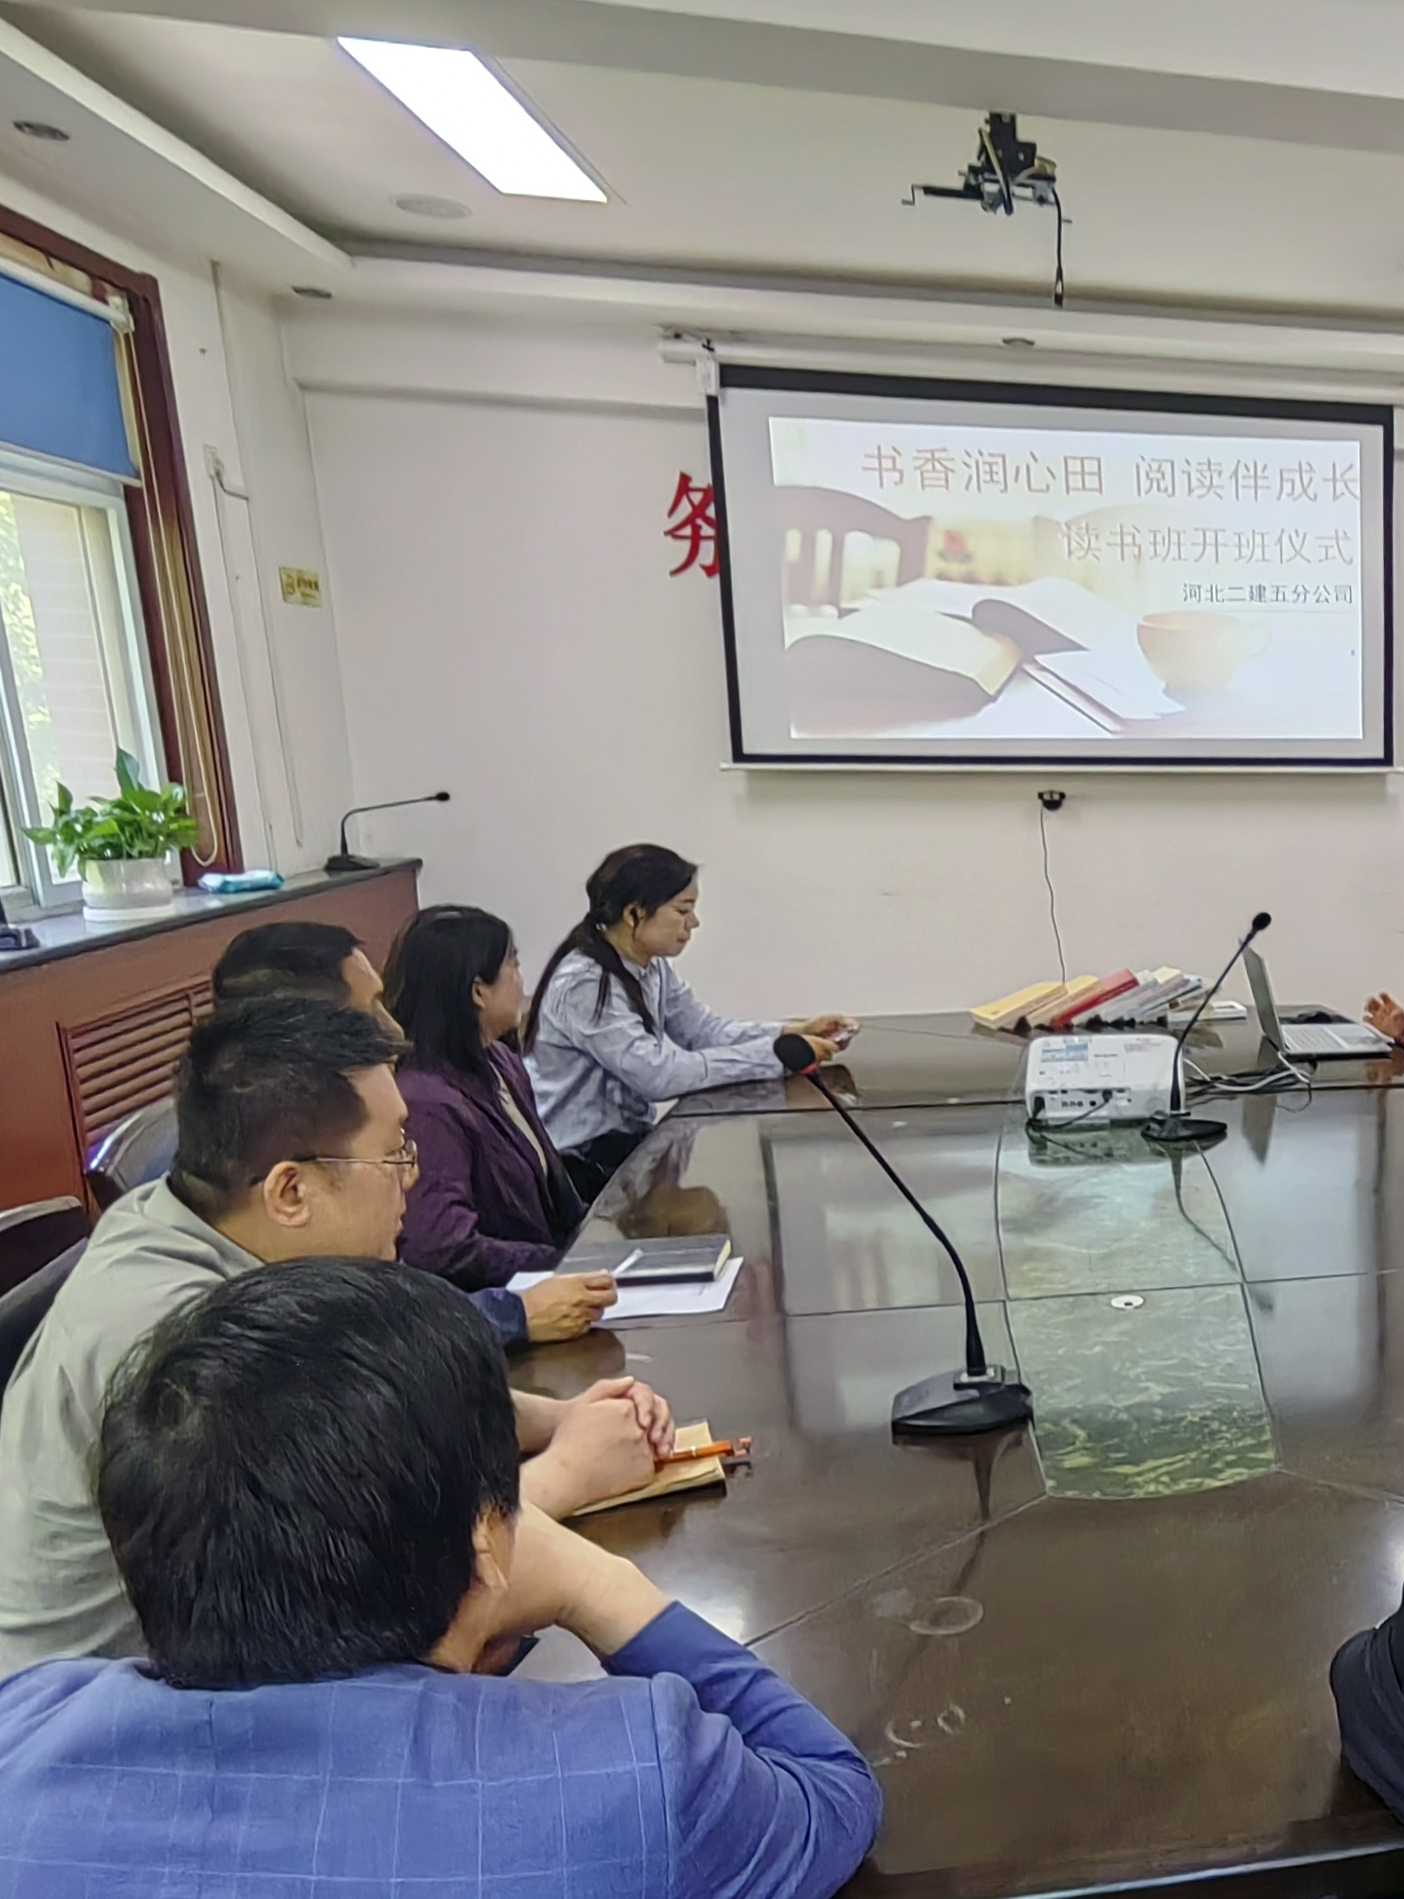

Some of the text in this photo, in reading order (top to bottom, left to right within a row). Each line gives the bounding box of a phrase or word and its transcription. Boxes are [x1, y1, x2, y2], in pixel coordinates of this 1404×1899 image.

[861, 444, 1360, 504] 书香润心田 阅读伴成长
[1060, 520, 1355, 566] 读书班开班仪式
[1182, 582, 1354, 605] 河北二建五分公司
